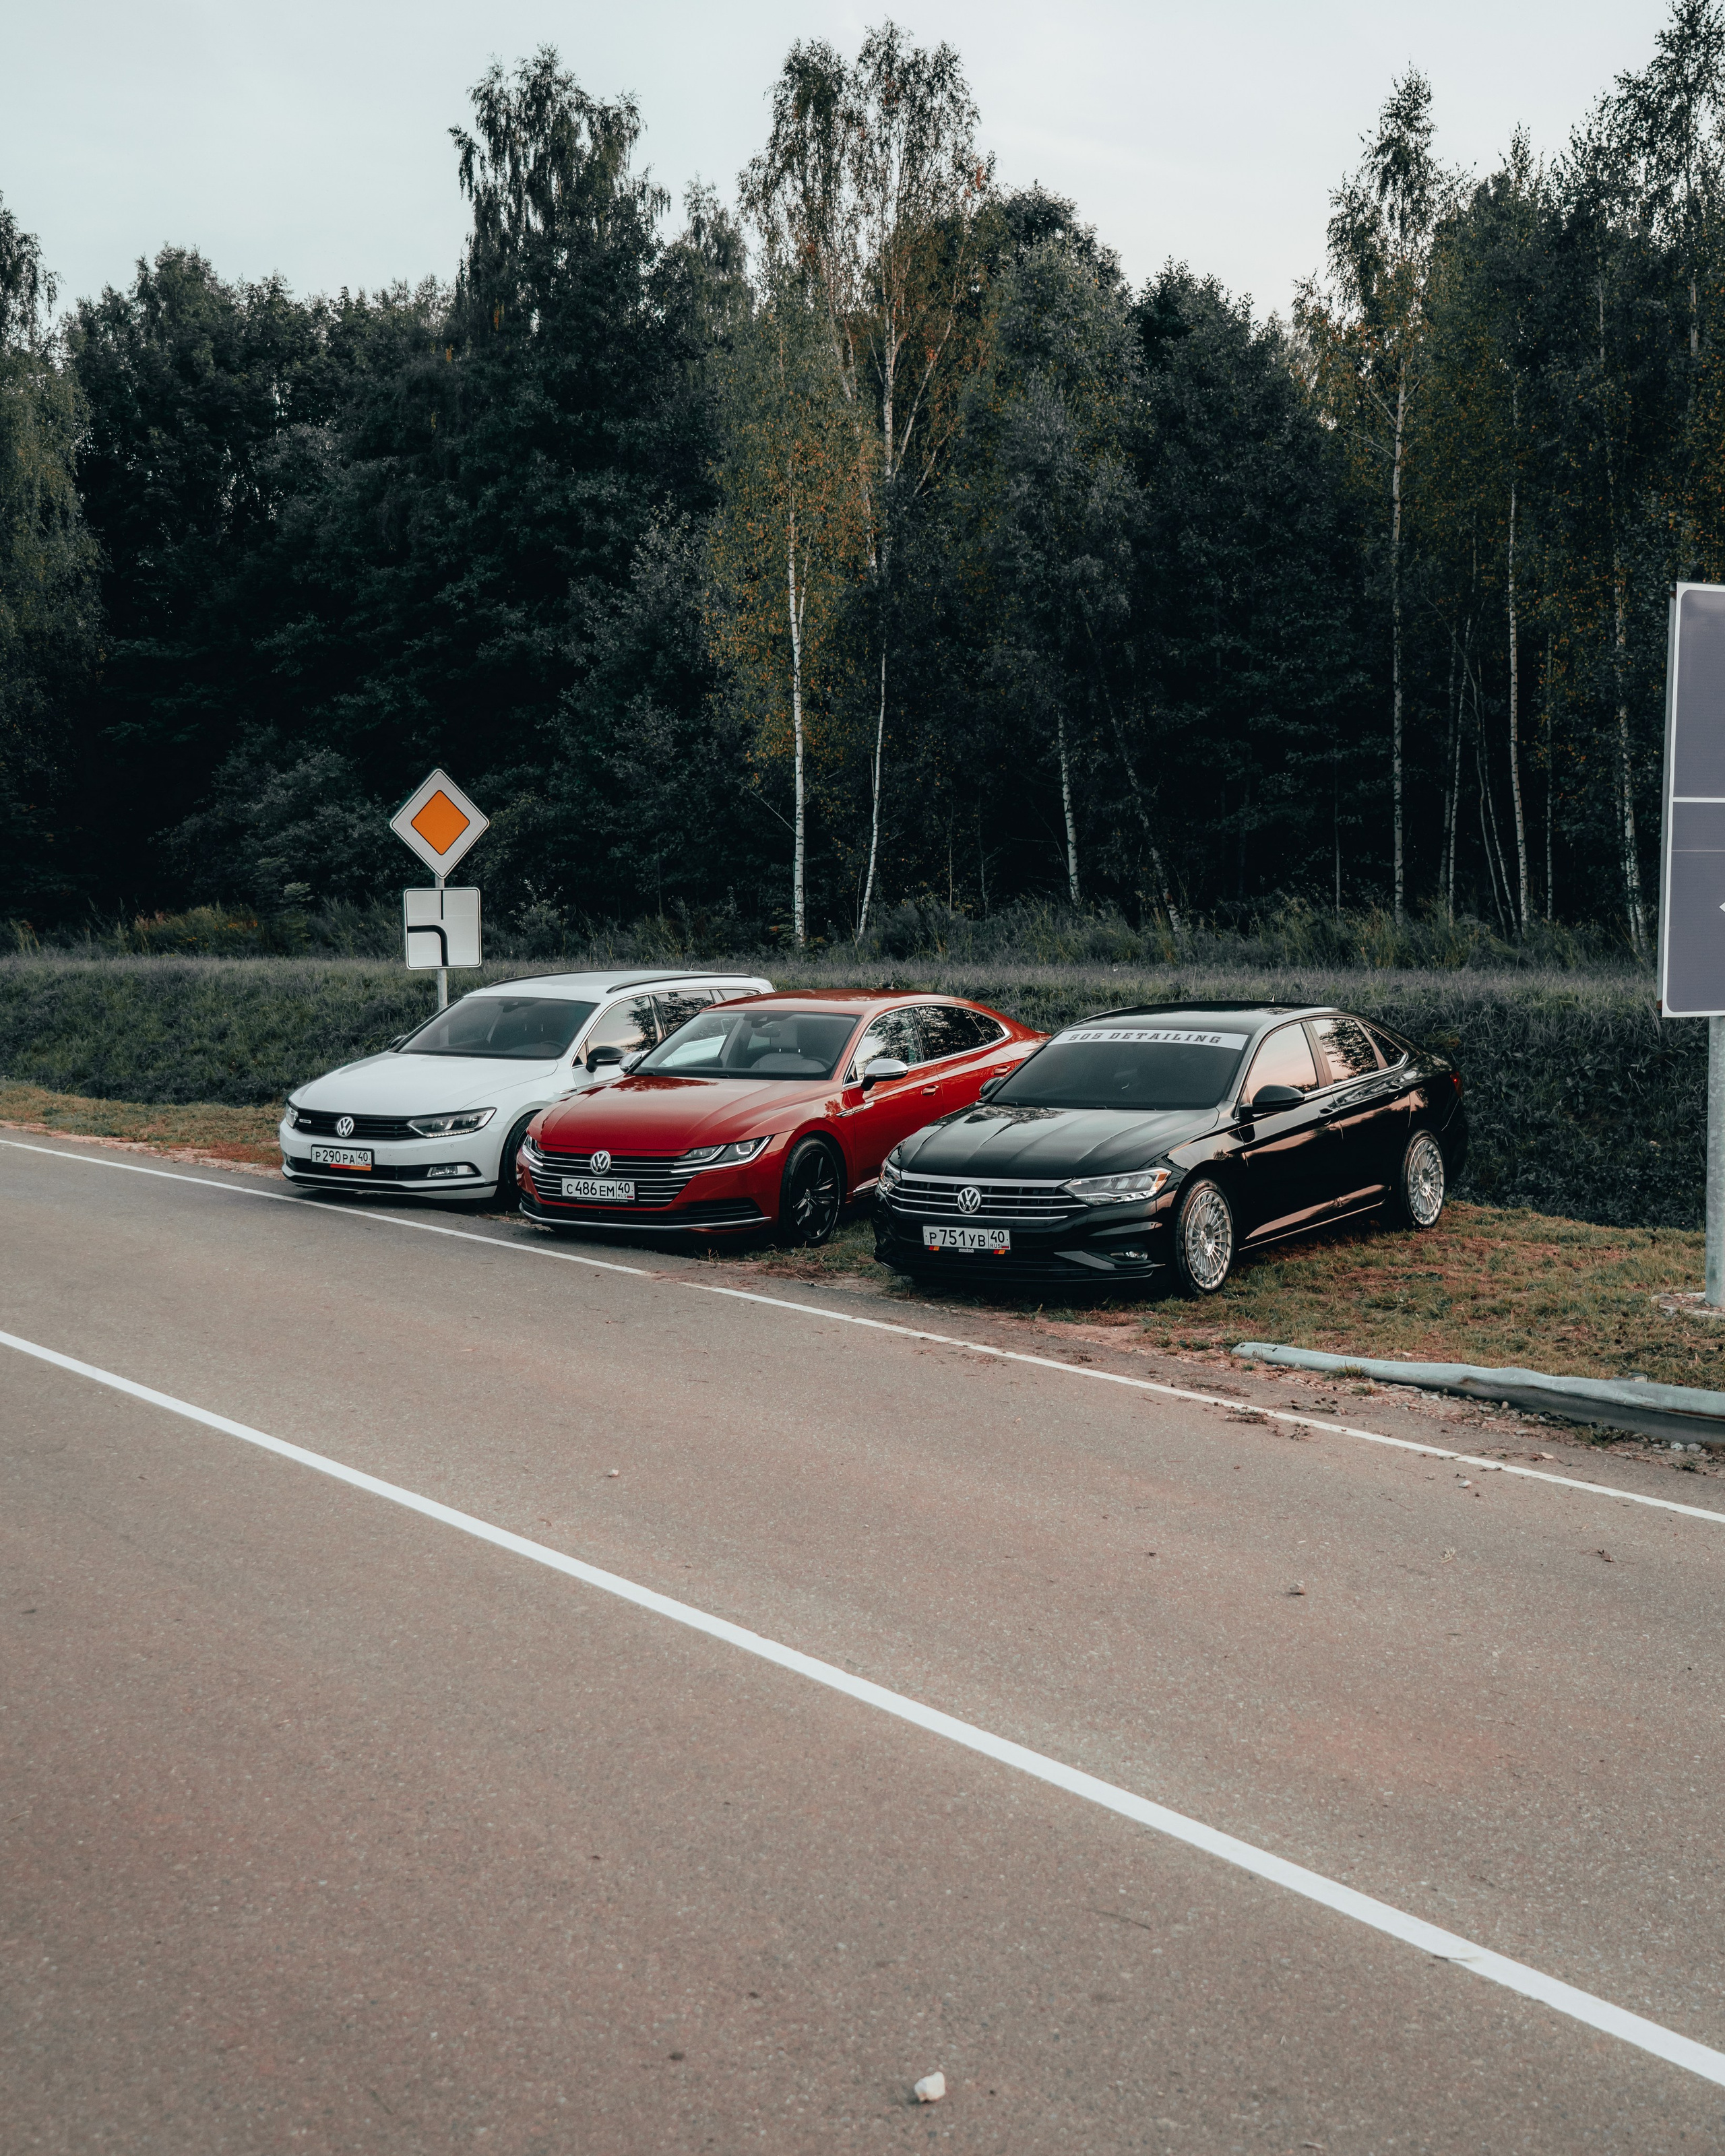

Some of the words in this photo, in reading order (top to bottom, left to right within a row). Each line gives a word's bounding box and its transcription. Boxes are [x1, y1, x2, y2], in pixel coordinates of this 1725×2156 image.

[1067, 1033, 1104, 1041] SOS
[1108, 1032, 1222, 1044] DETAILING
[358, 1152, 368, 1162] 40
[618, 1182, 630, 1193] 40
[991, 1230, 1005, 1243] 40
